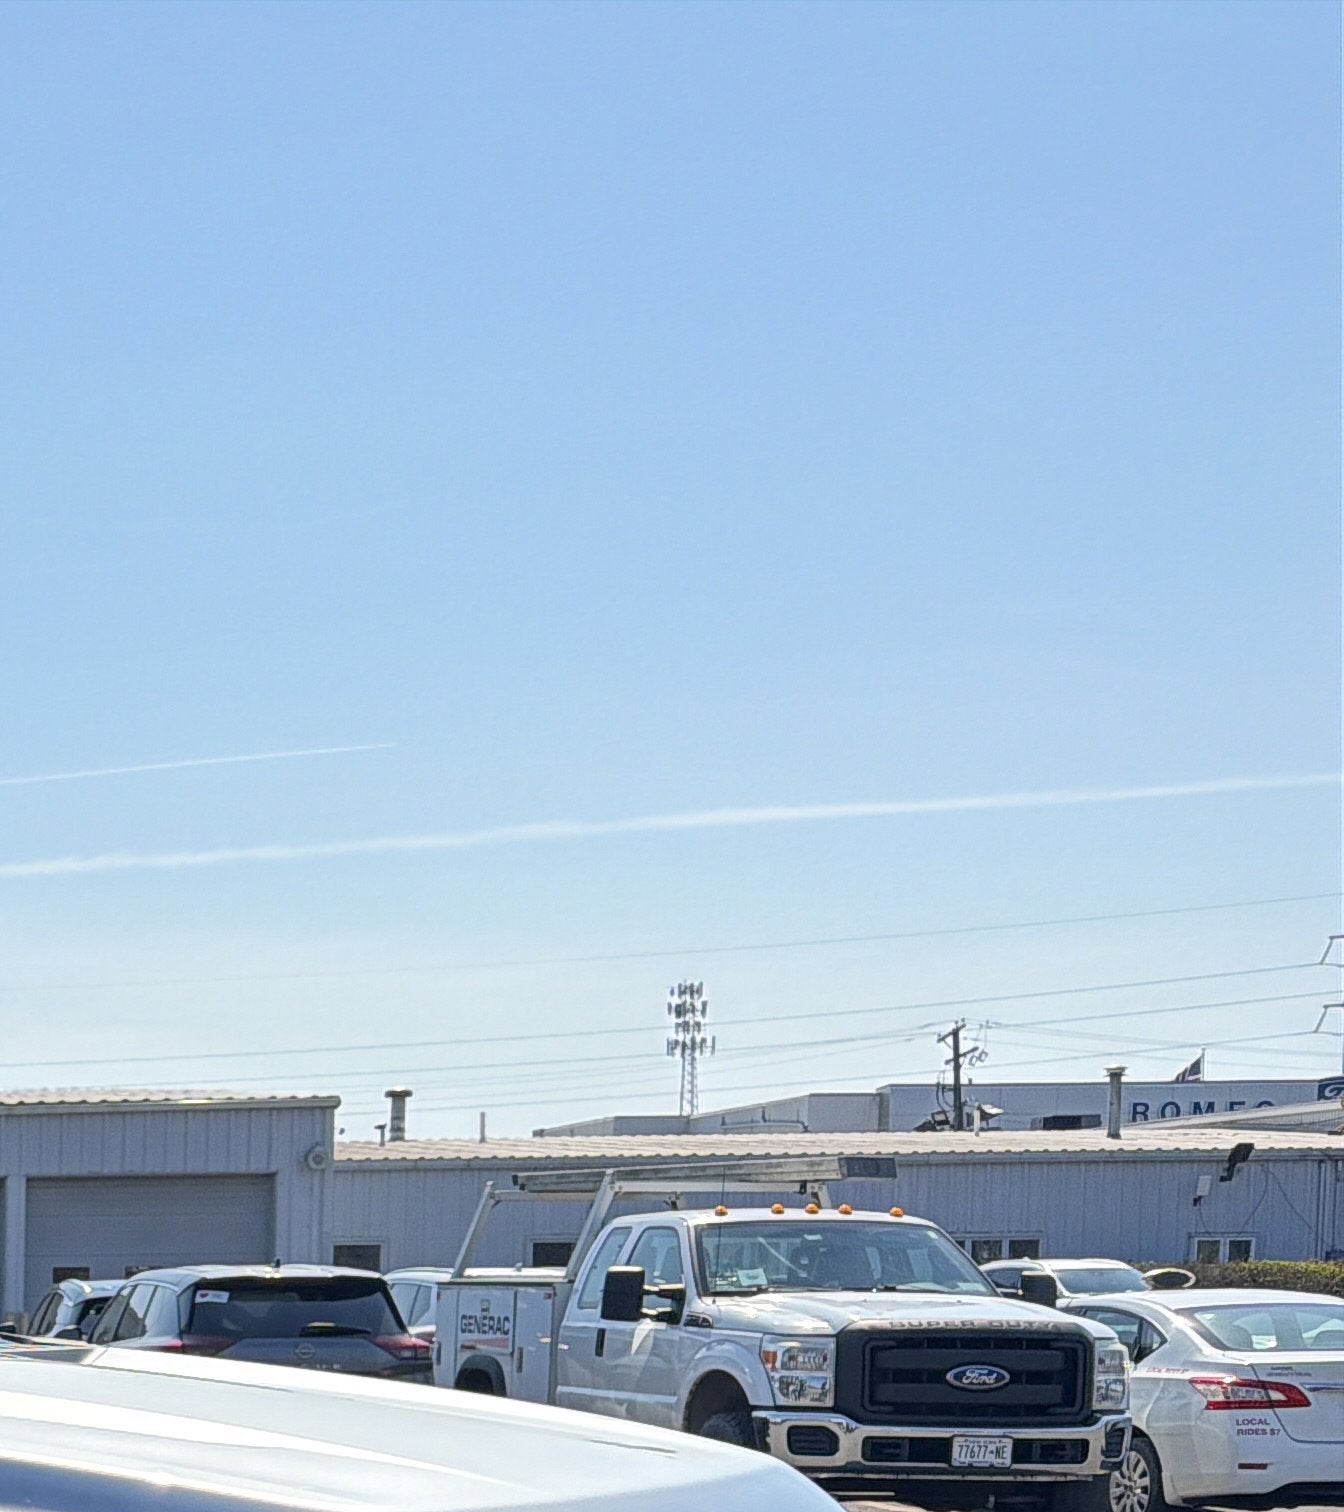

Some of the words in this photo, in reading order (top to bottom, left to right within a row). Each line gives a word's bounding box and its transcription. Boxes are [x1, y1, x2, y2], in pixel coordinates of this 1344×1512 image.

[460, 1314, 511, 1336] GENERAC
[962, 1368, 999, 1385] Ford
[1235, 1418, 1271, 1427] LOCAL
[1236, 1428, 1268, 1437] RIDES
[958, 1444, 989, 1460] 77677
